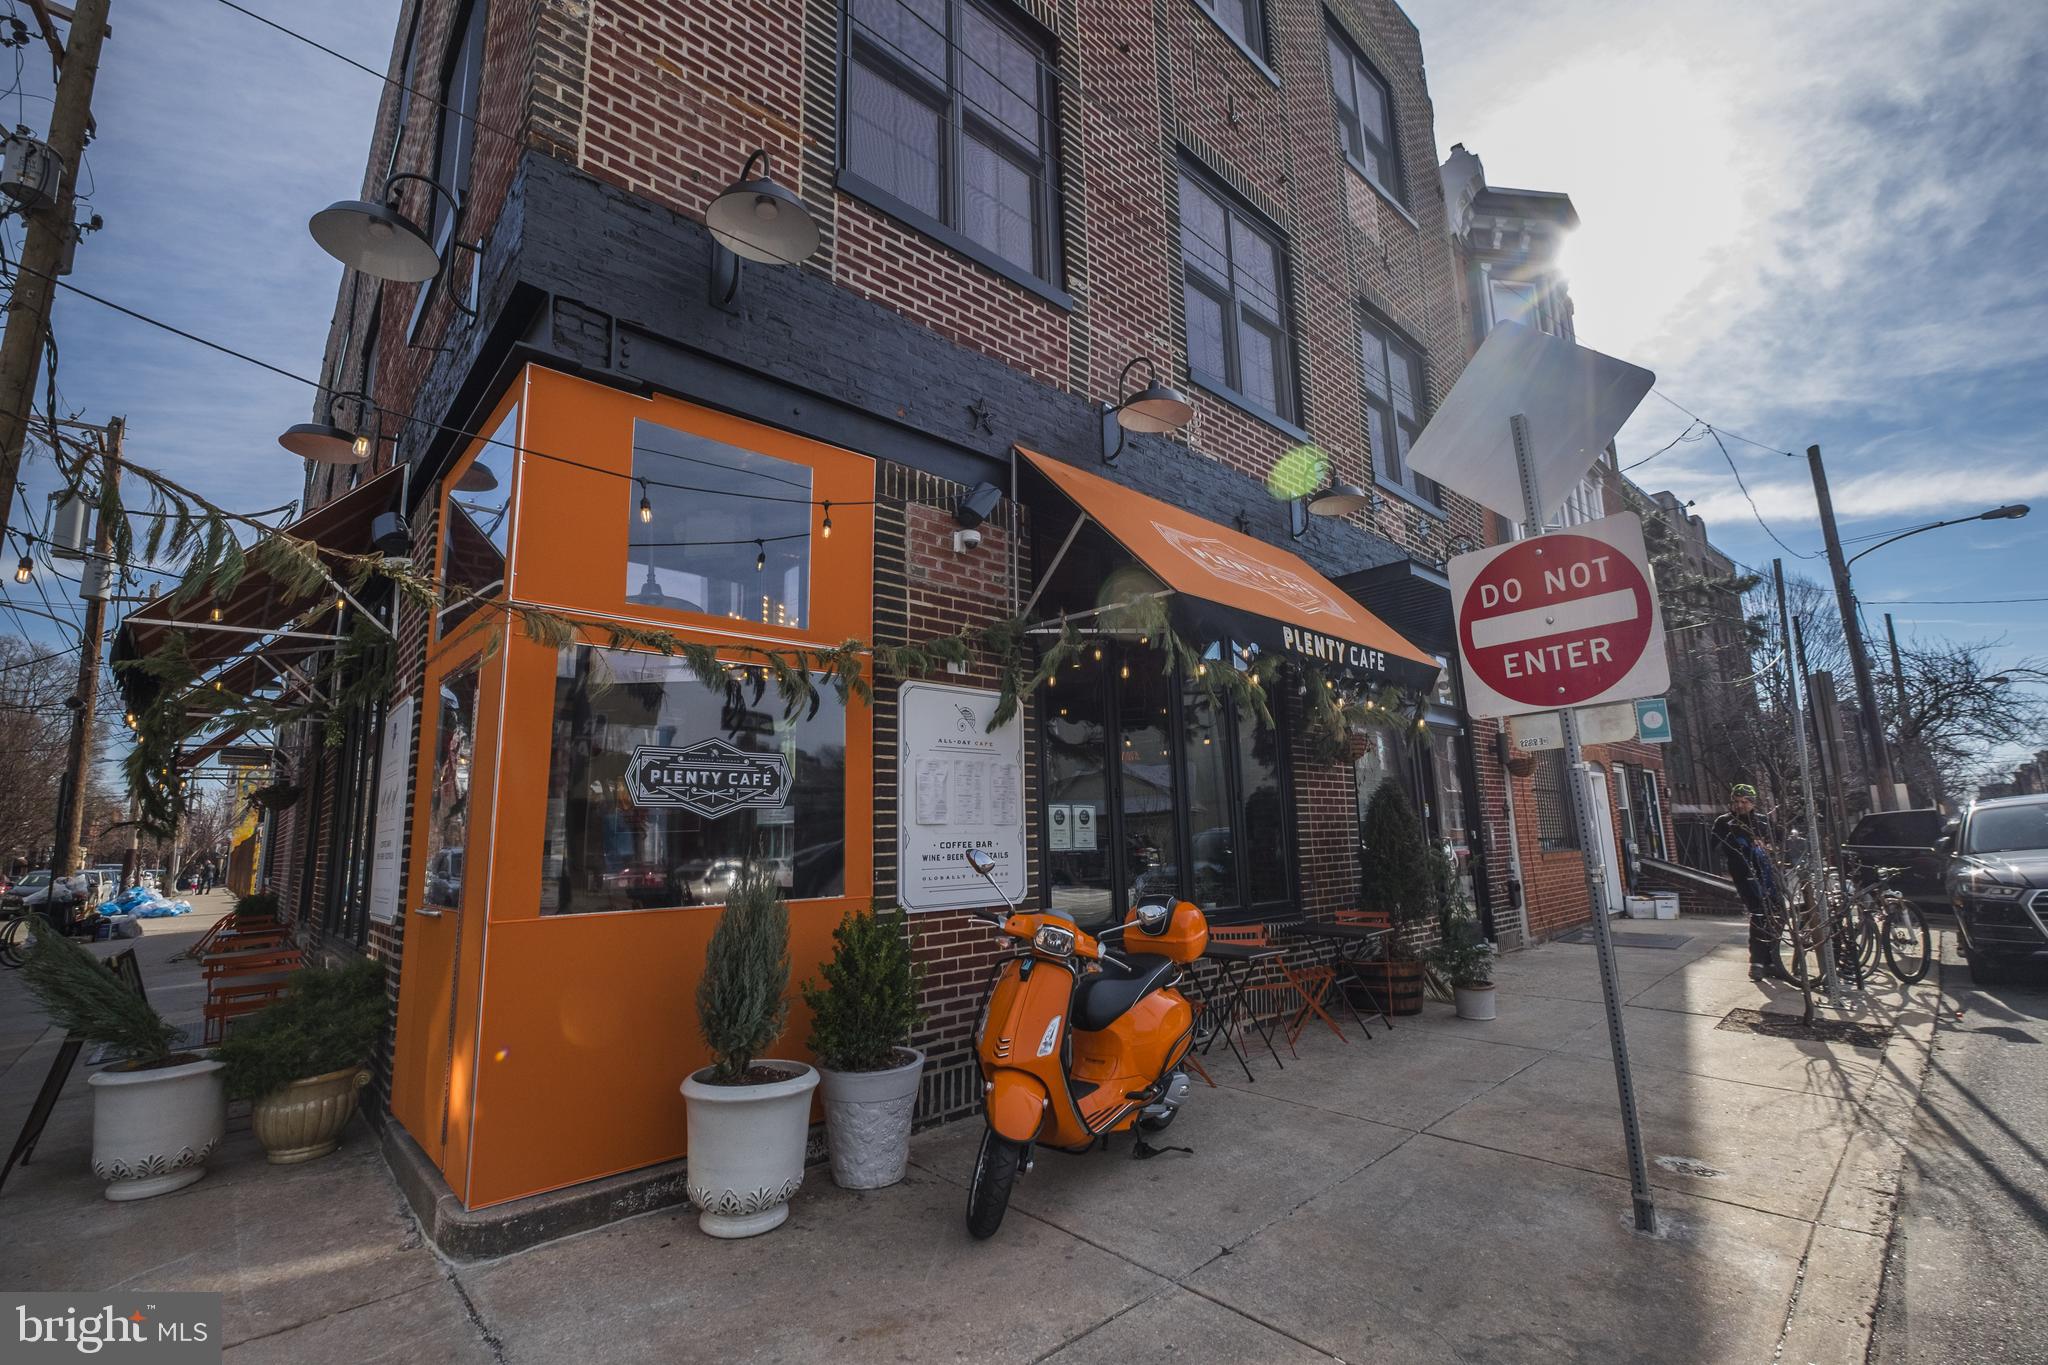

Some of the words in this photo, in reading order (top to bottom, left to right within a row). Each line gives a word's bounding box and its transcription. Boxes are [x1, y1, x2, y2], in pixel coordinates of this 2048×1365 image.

[1480, 578, 1522, 608] DO
[1544, 556, 1611, 594] NOT
[1282, 625, 1345, 664] PLENTY
[1350, 646, 1385, 671] CAFE
[1503, 637, 1613, 679] ENTER
[650, 769, 723, 786] PLENTY
[728, 771, 772, 786] CAFÉ
[940, 841, 973, 849] COFFEE
[975, 840, 993, 848] BAR
[946, 853, 964, 861] BEER
